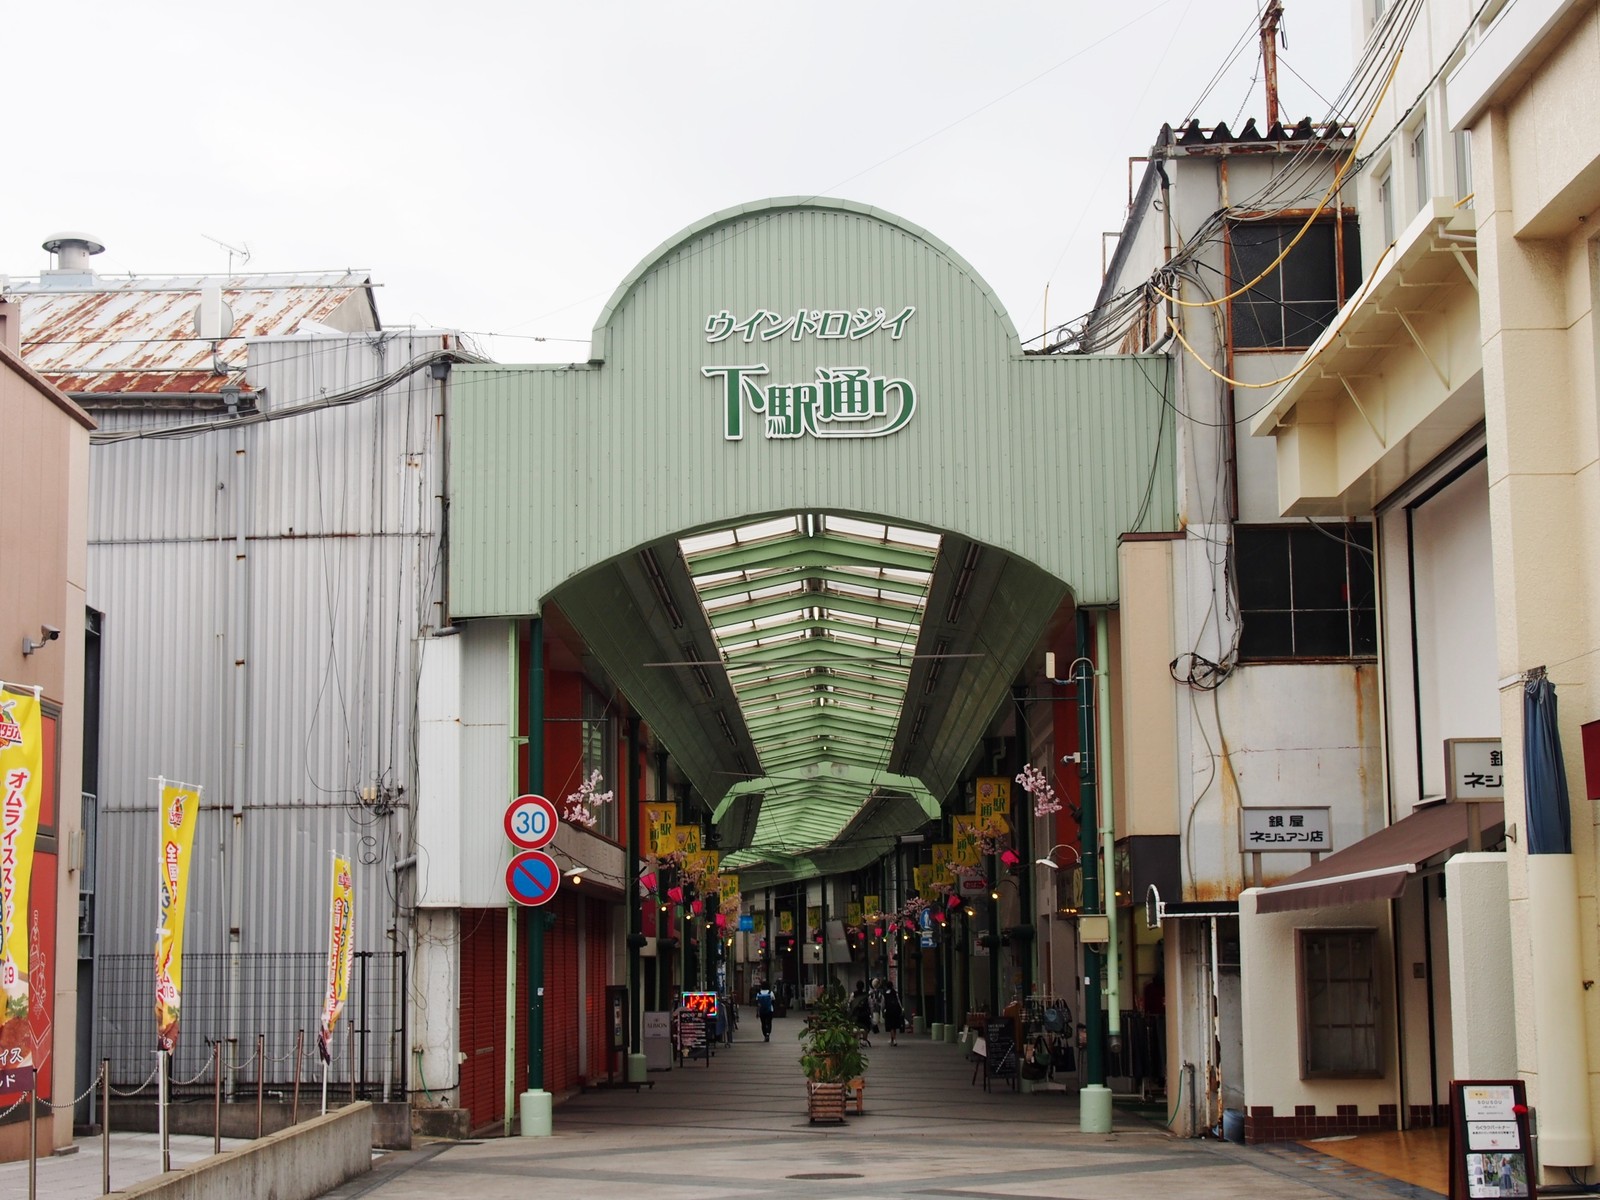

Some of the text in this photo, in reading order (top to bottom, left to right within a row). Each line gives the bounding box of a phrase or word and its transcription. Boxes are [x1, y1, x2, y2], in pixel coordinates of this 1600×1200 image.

[705, 306, 916, 343] ウインドロジイ
[701, 362, 917, 441] 下駅通り
[1490, 750, 1503, 766] 銀
[516, 811, 546, 834] 30
[0, 1074, 16, 1088] ド
